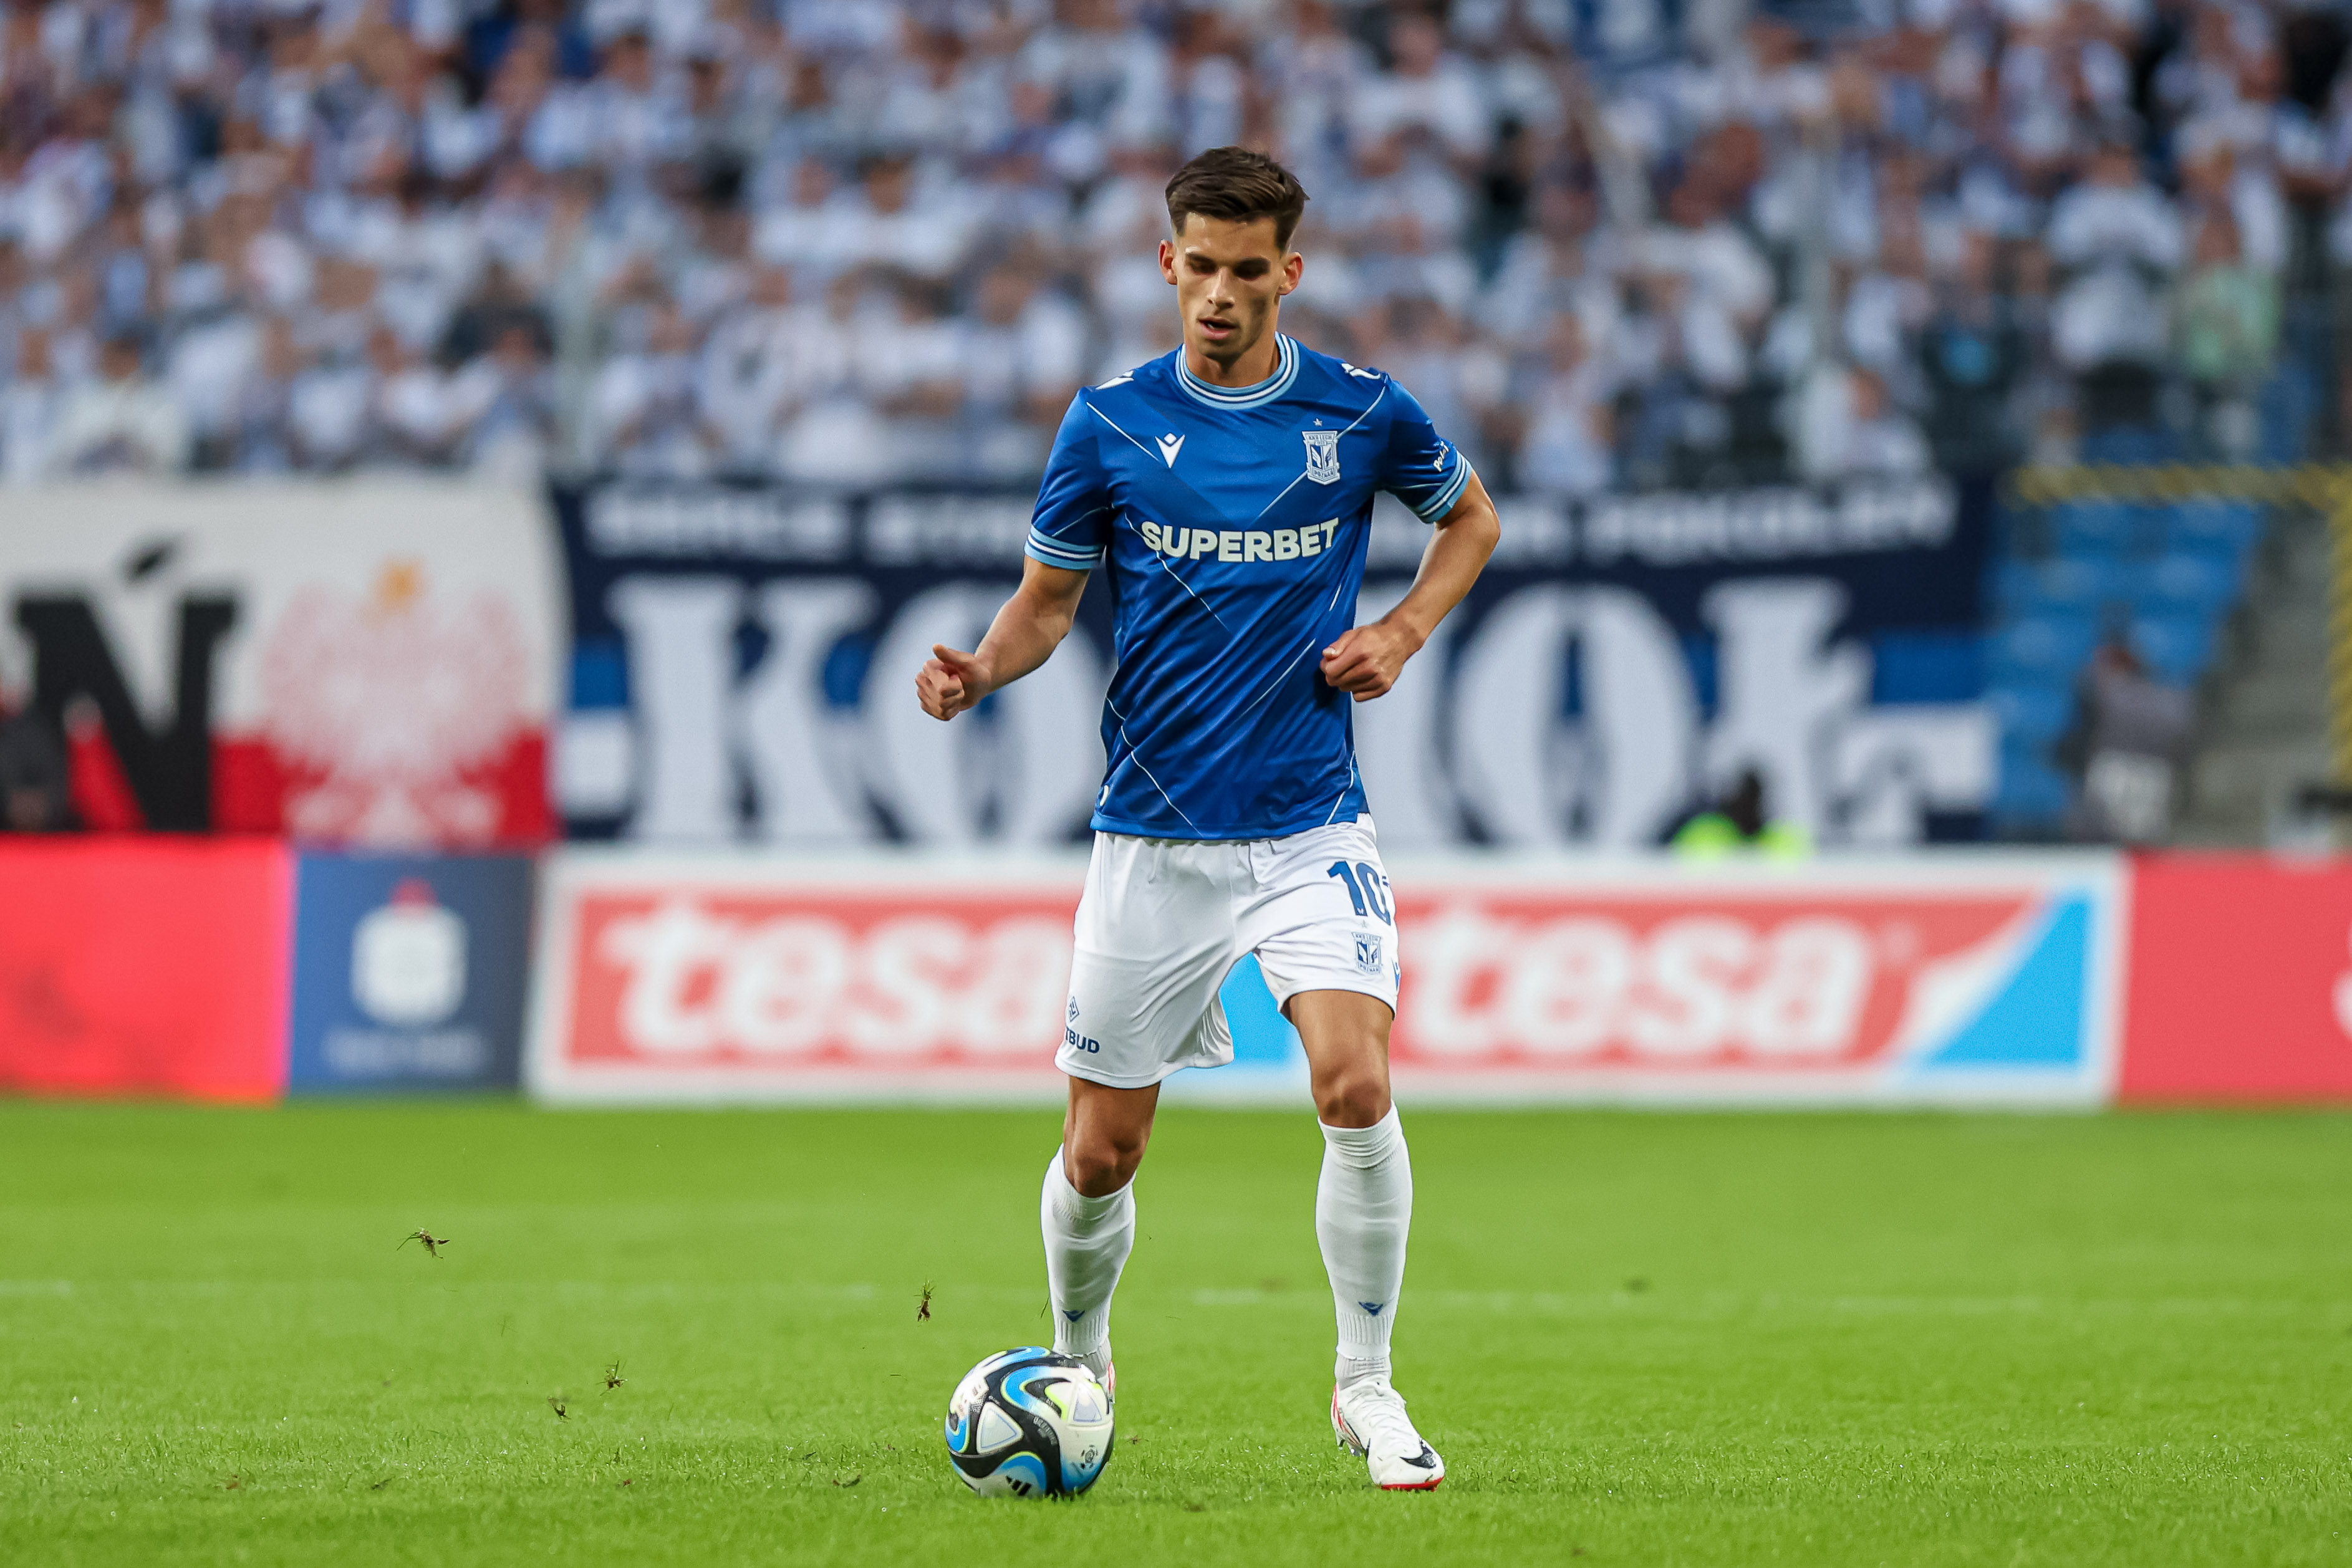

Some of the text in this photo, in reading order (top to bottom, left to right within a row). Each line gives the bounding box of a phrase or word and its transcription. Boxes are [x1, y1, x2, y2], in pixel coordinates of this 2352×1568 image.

[1141, 517, 1339, 562] SUPERBET
[1326, 860, 1391, 926] 10
[1394, 898, 1868, 1054] tesa
